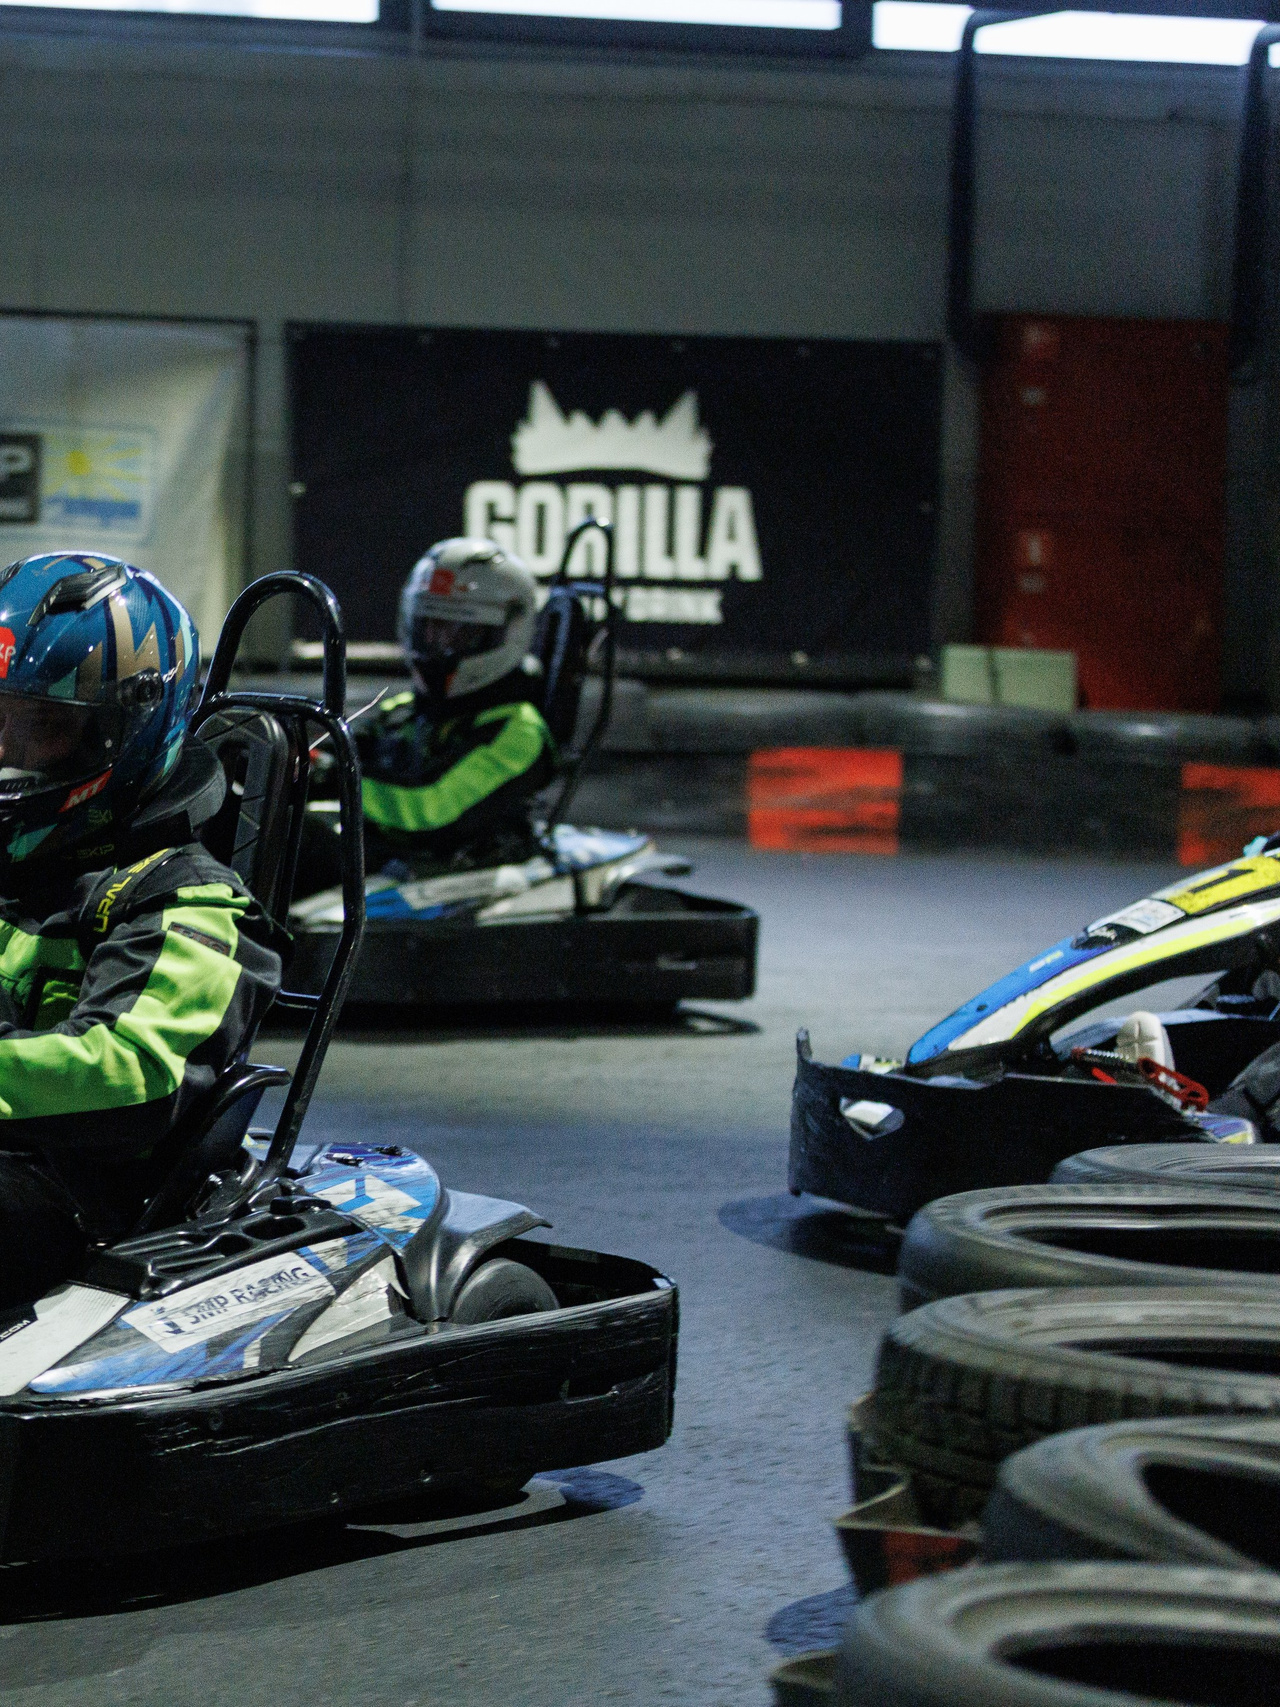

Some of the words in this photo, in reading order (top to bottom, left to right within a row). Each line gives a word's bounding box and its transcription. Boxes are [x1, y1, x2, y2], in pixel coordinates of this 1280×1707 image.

[464, 480, 764, 581] GORILLA
[66, 777, 106, 808] MT
[93, 876, 132, 932] URAL
